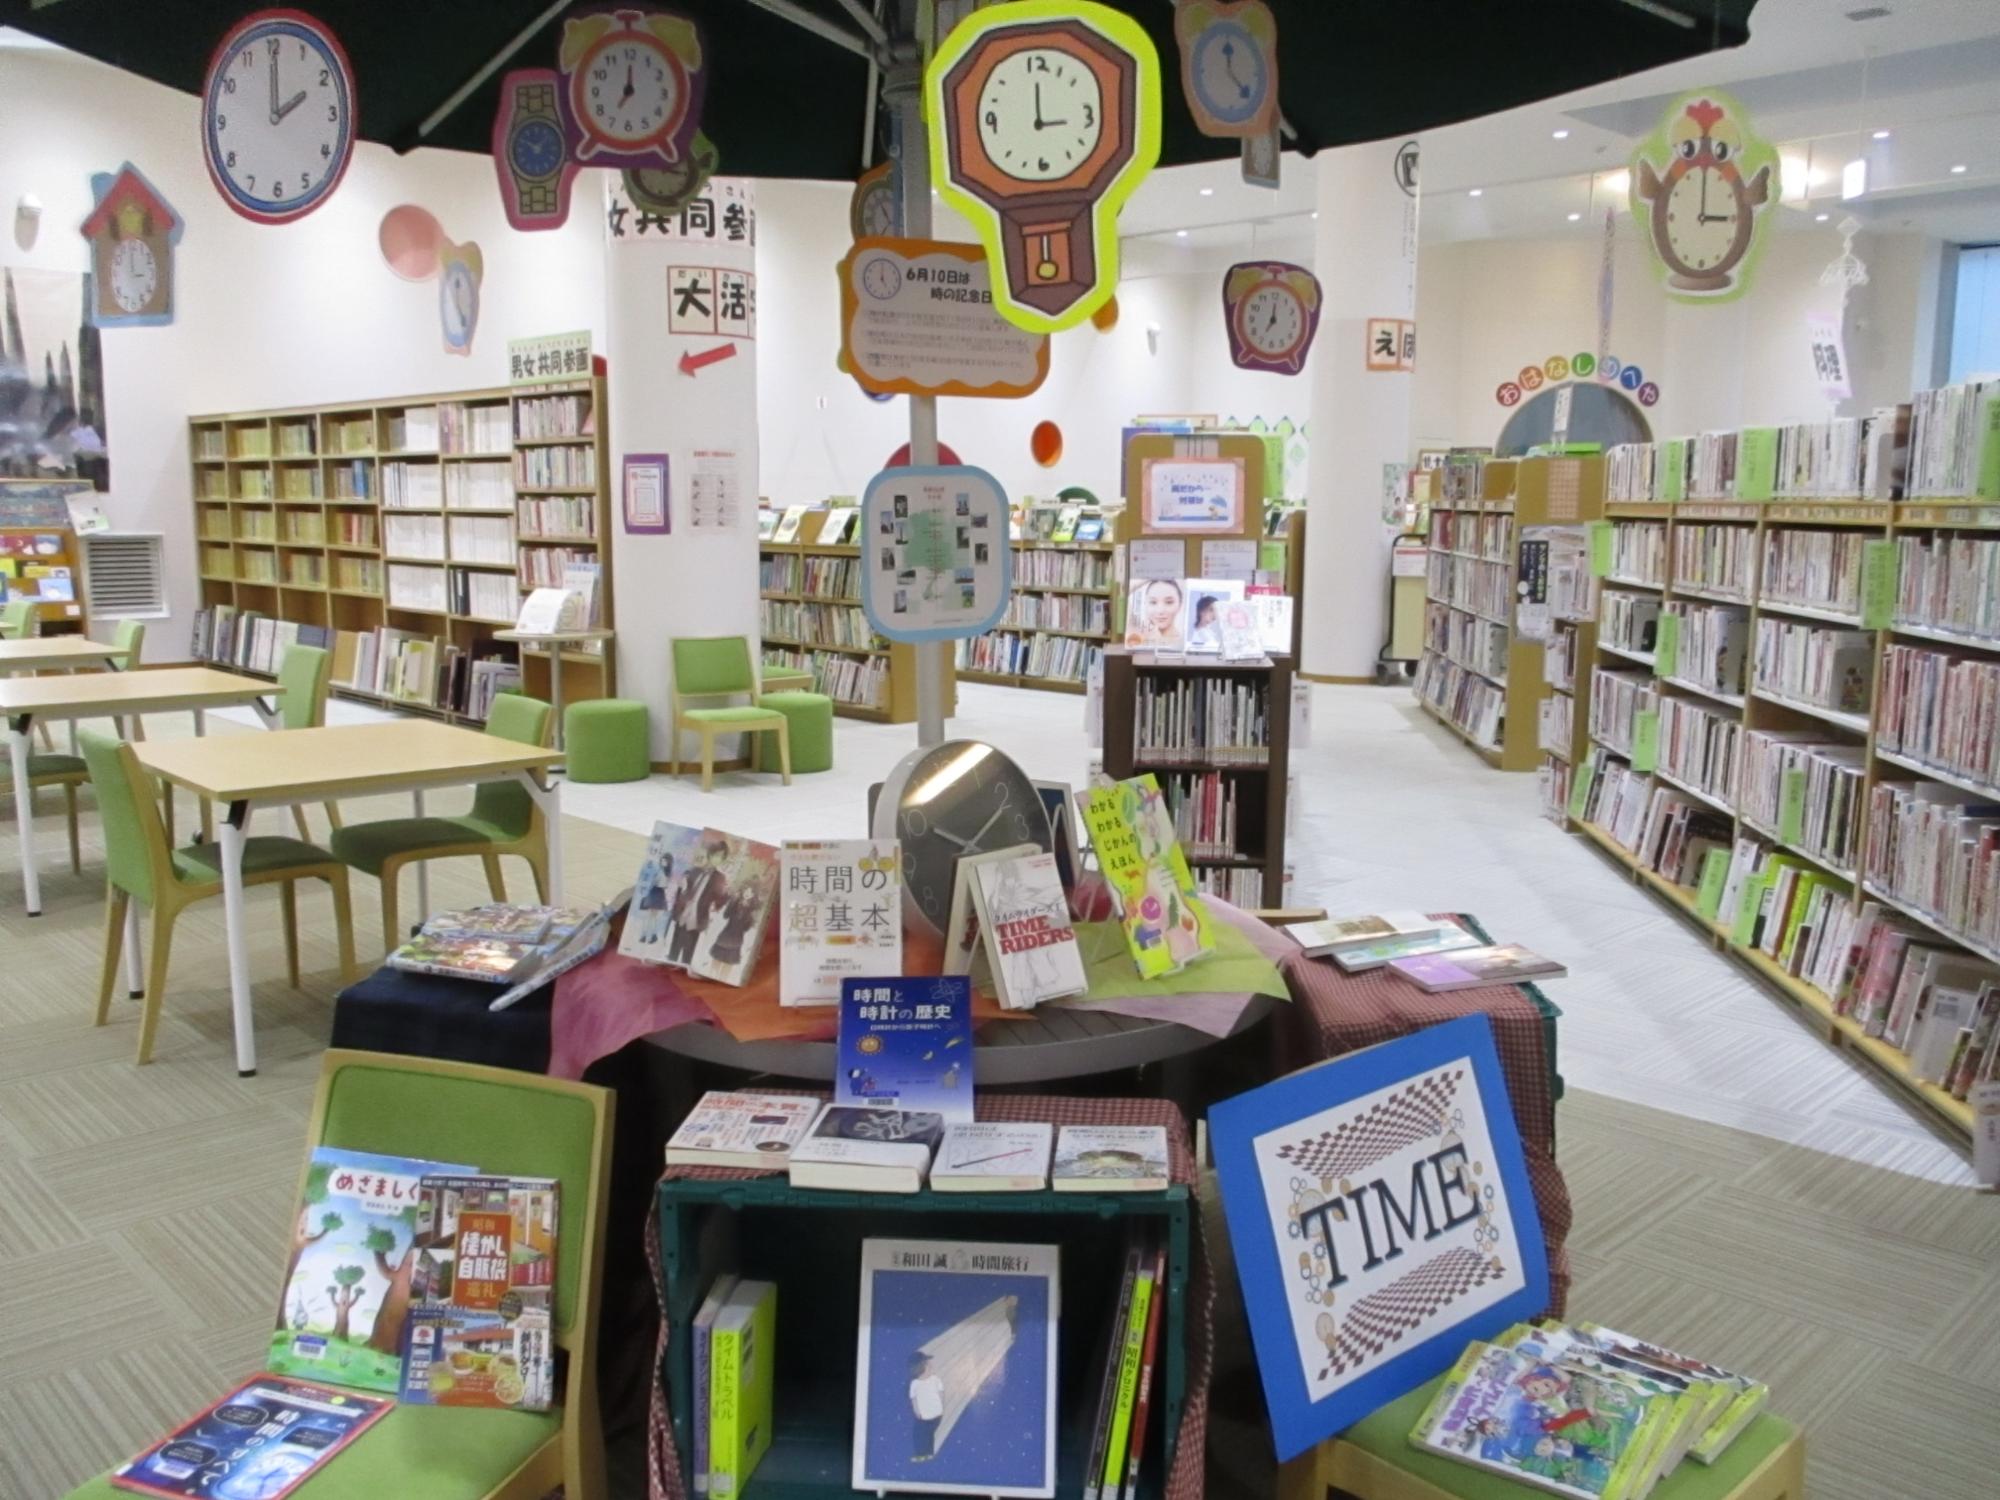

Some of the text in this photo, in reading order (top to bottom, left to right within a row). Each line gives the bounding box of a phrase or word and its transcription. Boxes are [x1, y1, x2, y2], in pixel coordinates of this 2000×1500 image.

[266, 38, 280, 55] 12
[299, 45, 306, 60] 1
[624, 48, 636, 60] 12
[242, 51, 253, 67] 11
[606, 55, 617, 67] 11
[645, 56, 651, 68] 1
[1027, 56, 1050, 74] 12
[319, 70, 329, 86] 2
[593, 69, 607, 80] 10
[655, 68, 663, 82] 2
[223, 79, 236, 94] 10
[591, 86, 600, 98] 9
[661, 88, 668, 100] 3
[328, 106, 337, 122] 3
[596, 103, 604, 116] 8
[1083, 103, 1094, 129] 3
[217, 114, 226, 130] 9
[608, 116, 616, 128] 7
[624, 119, 632, 132] 6
[641, 117, 650, 129] 5
[985, 111, 997, 134] 9
[226, 152, 236, 168] 8
[320, 144, 331, 160] 4
[1038, 157, 1050, 172] 6
[246, 176, 255, 192] 7
[301, 173, 310, 189] 5
[273, 181, 282, 198] 6
[906, 267, 970, 285] 6月10日は
[930, 287, 992, 304] 時の記念日
[511, 346, 588, 379] 男女共同参画
[1498, 354, 1657, 406] おはなしのへや
[1089, 798, 1116, 815] わかる
[1096, 816, 1122, 833] わかる
[1103, 831, 1137, 851] じかんの
[1110, 856, 1136, 871] えほん
[788, 865, 888, 895] 時間の
[788, 902, 890, 932] 超基本
[995, 914, 1050, 938] TIME
[999, 926, 1074, 956] RIDERS
[853, 987, 904, 1003] 時間と
[859, 1003, 952, 1021] 時計の歴史
[335, 1173, 419, 1200] めざましく
[1300, 1142, 1482, 1290] TIME
[460, 1231, 507, 1257] 懐かし
[457, 1257, 507, 1281] 自販機
[971, 1255, 1030, 1272] 時間旅行
[720, 1333, 735, 1420] タイムトラベル
